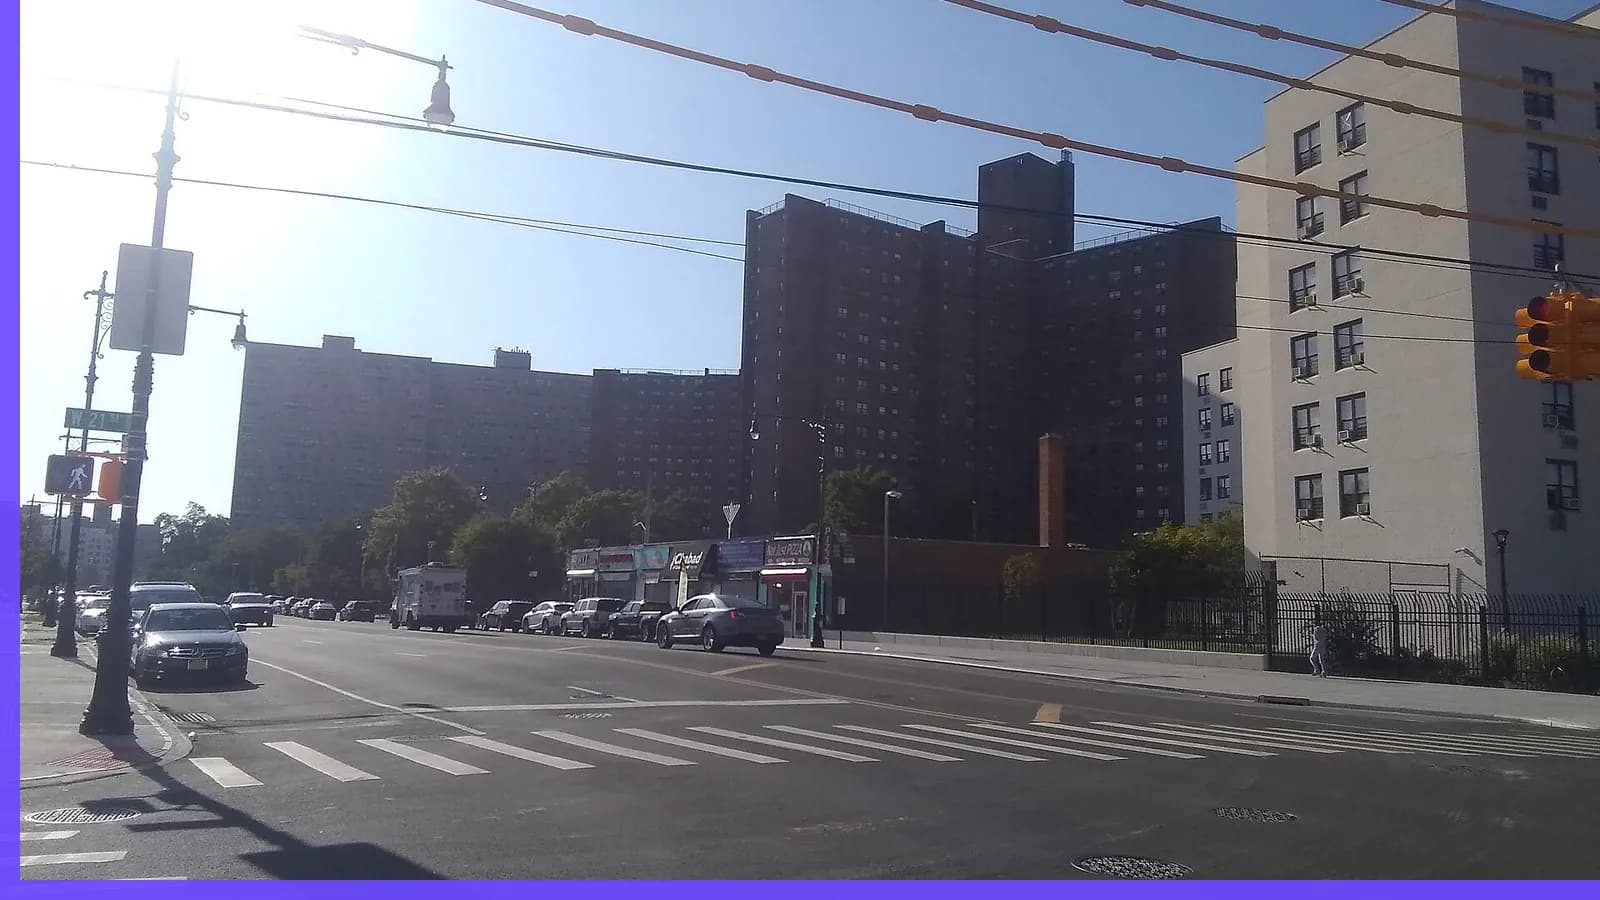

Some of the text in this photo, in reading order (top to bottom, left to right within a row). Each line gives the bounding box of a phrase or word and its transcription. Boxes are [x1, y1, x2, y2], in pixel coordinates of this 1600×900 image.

[71, 410, 83, 426] W
[88, 412, 105, 429] 21
[787, 542, 802, 556] PIZZA
